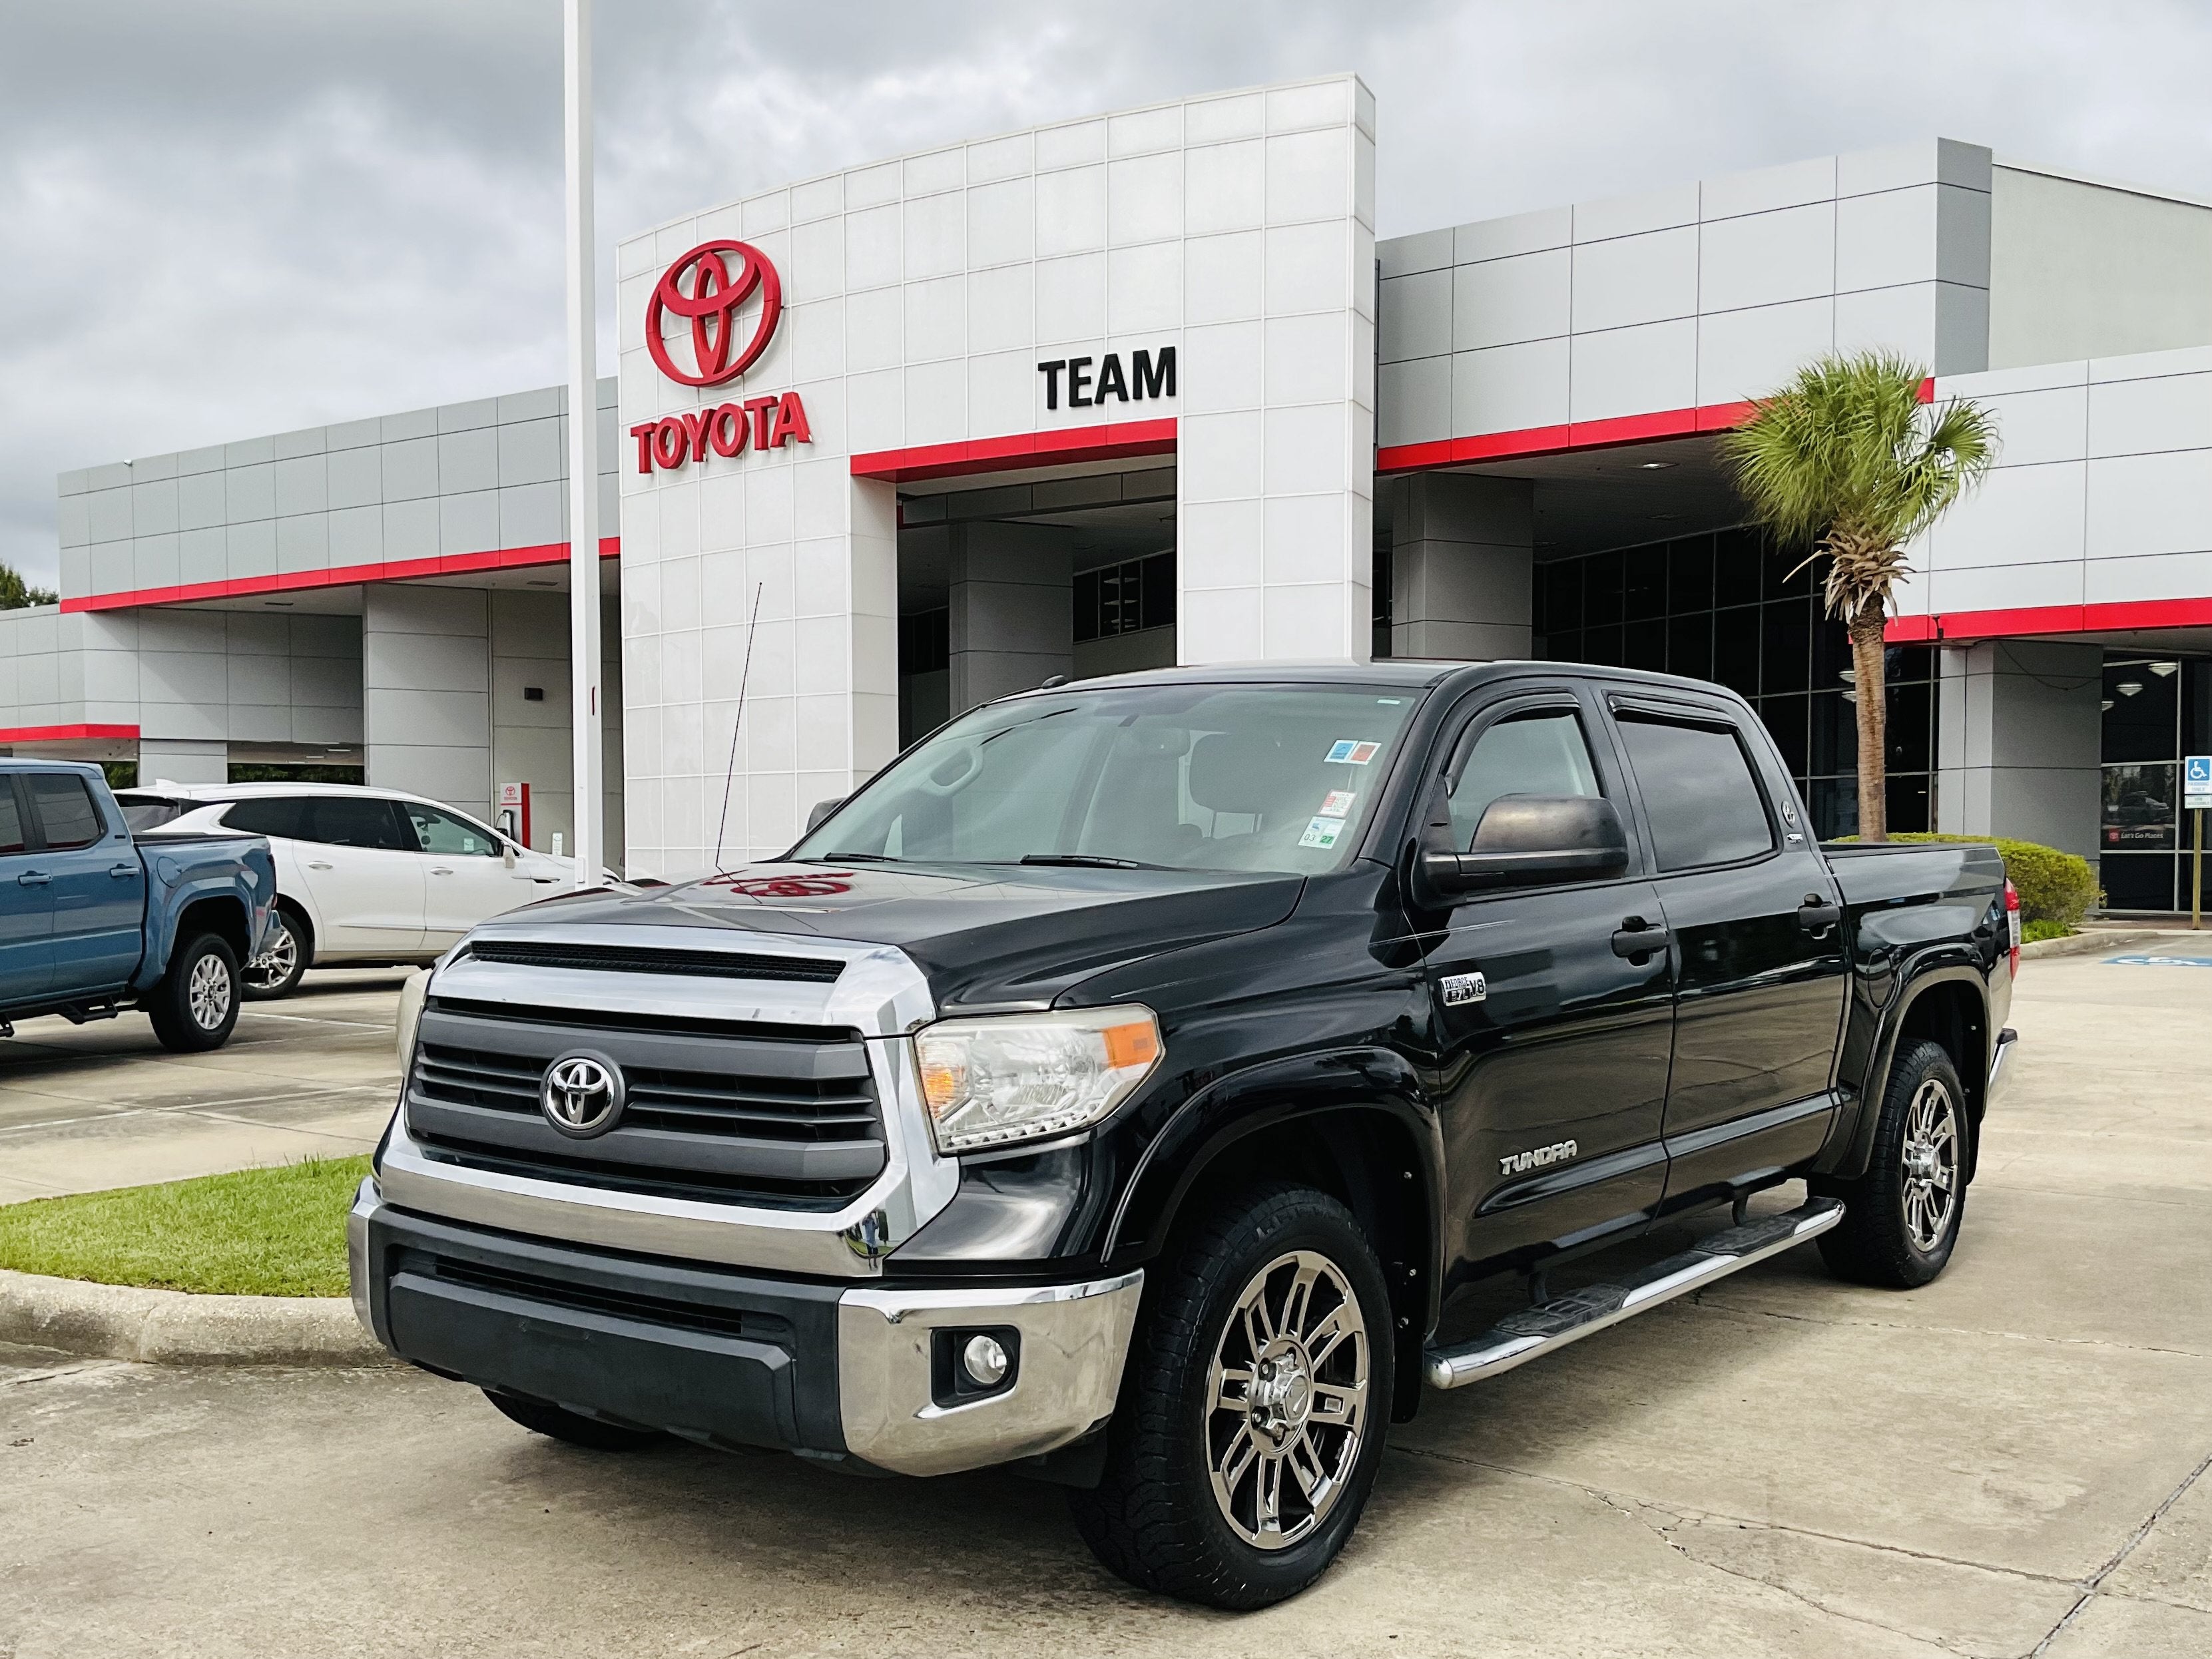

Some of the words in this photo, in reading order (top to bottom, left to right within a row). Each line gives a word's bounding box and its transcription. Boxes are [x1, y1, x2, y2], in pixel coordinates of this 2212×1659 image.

[1037, 346, 1177, 410] TEAM
[630, 391, 814, 474] TOYOTA
[1320, 835, 1334, 843] 27
[1469, 979, 1484, 995] V8
[1500, 1139, 1577, 1175] TUNDRA
